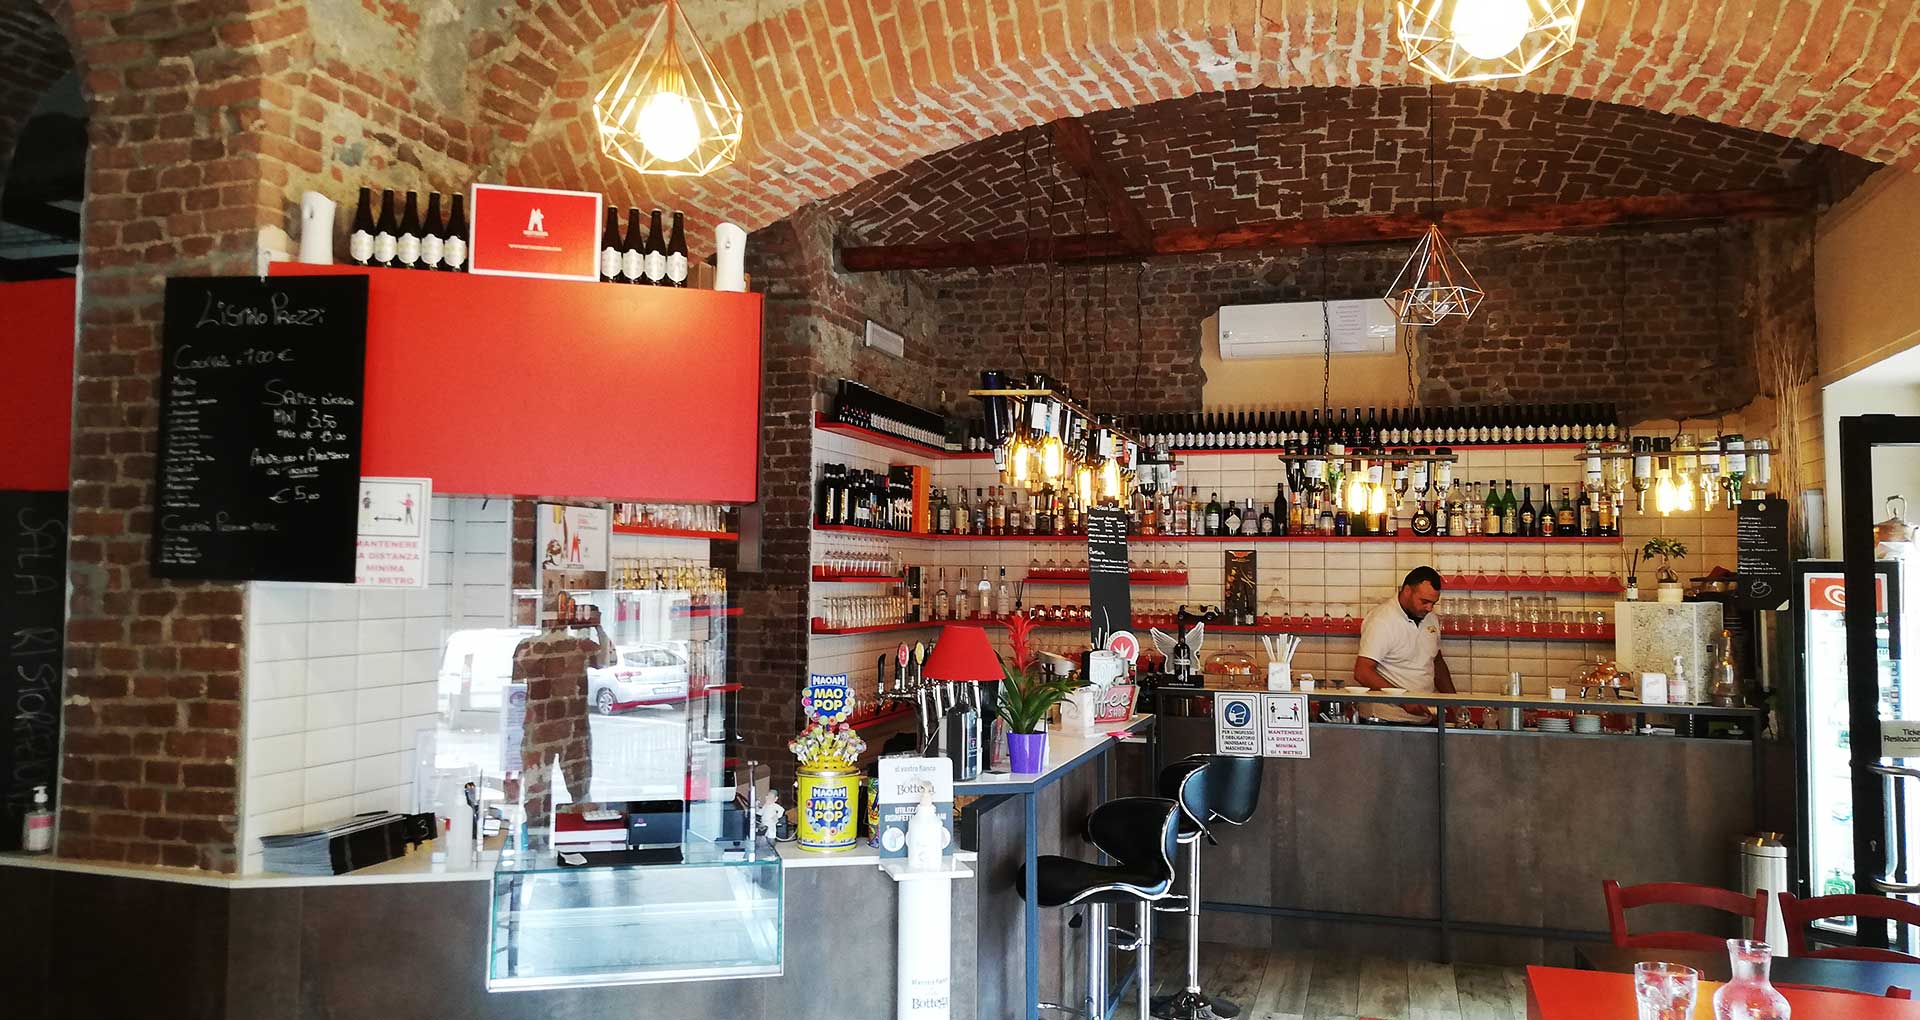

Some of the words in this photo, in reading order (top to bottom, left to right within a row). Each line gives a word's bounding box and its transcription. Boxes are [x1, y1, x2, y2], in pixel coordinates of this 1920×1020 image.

[14, 506, 65, 597] SALA
[368, 552, 420, 560] DISTANZA
[366, 564, 405, 573] MINIMA
[378, 577, 412, 585] METRO
[812, 675, 846, 686] MAOAM
[814, 688, 843, 699] MAO
[814, 699, 843, 711] POP
[1109, 705, 1127, 717] SHOP
[812, 787, 846, 798] MAOAM
[897, 784, 936, 796] Bottea
[815, 800, 844, 811] MAO
[815, 811, 844, 823] POP
